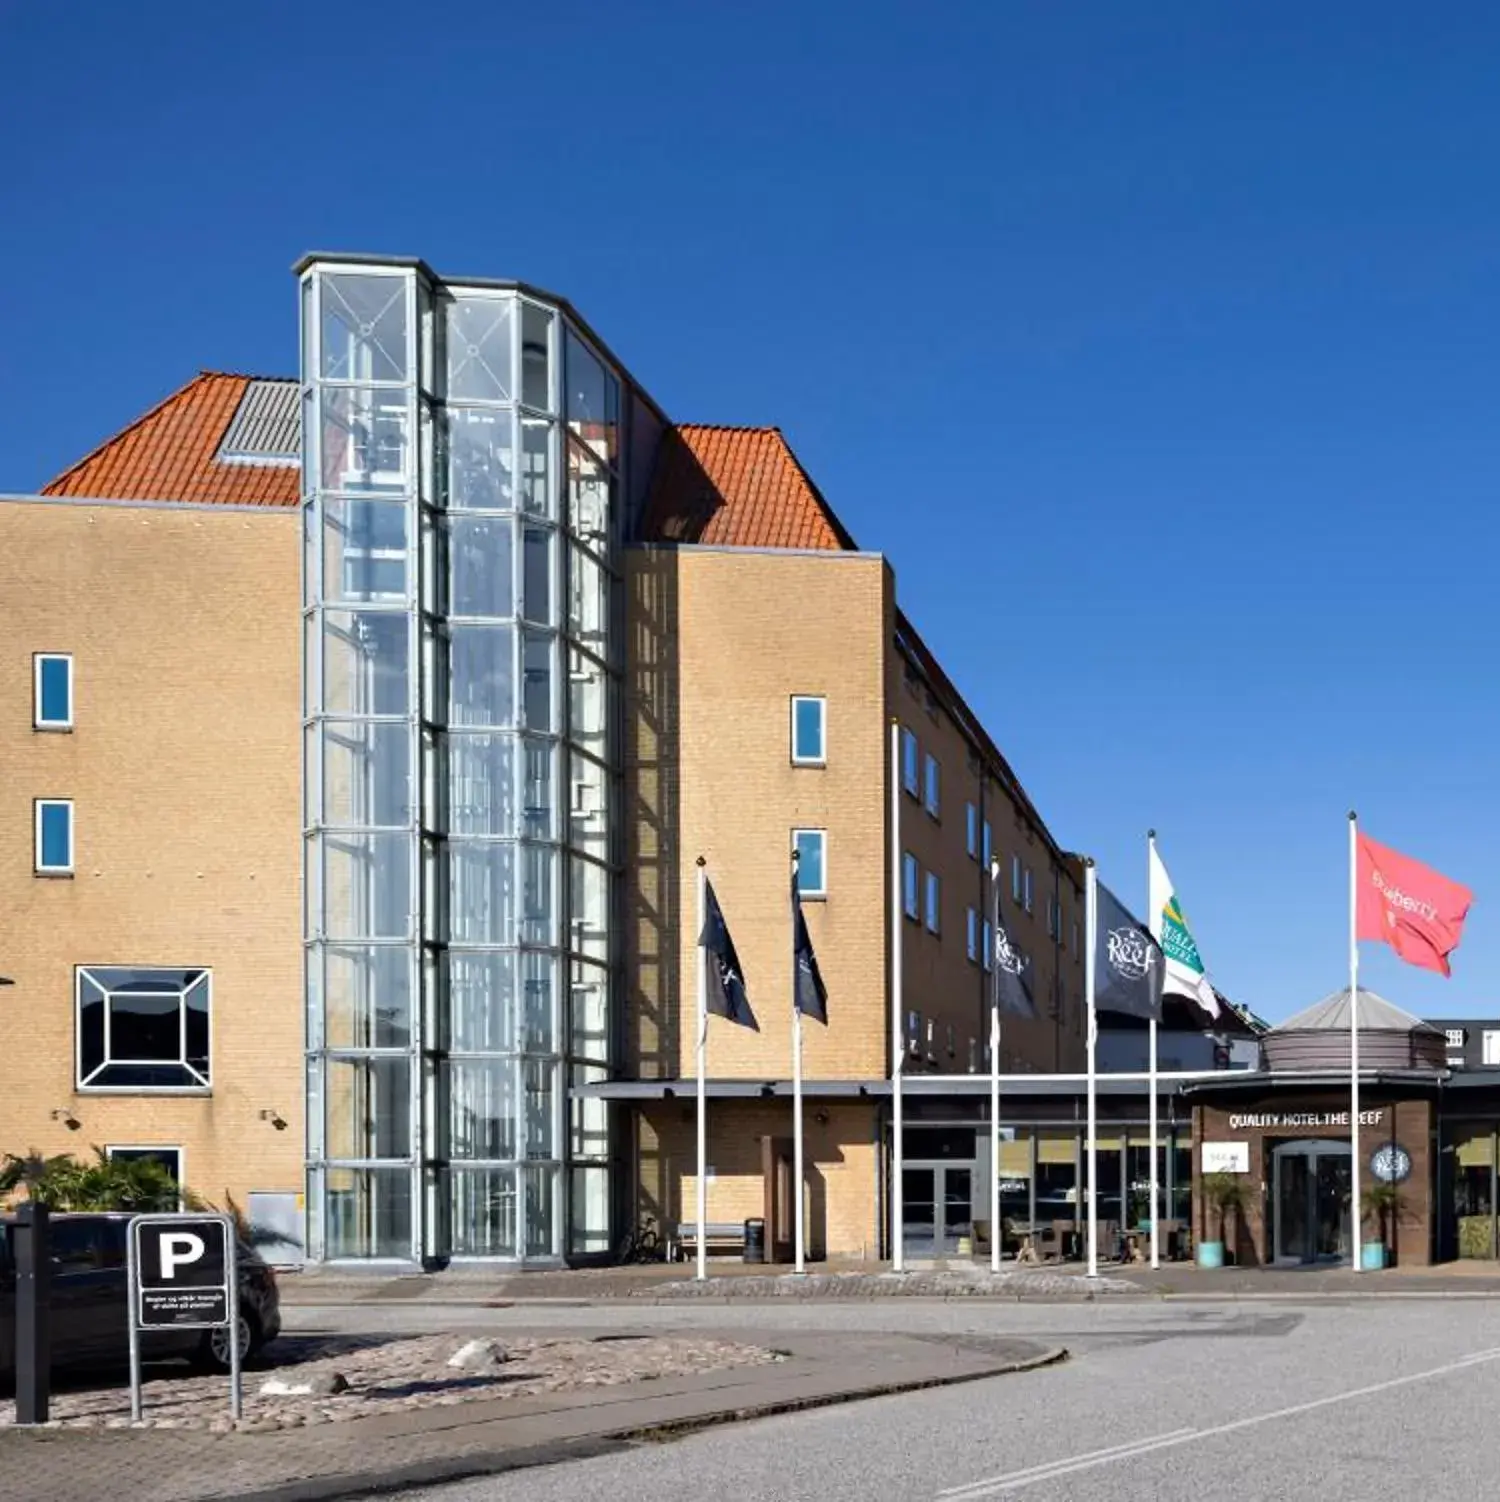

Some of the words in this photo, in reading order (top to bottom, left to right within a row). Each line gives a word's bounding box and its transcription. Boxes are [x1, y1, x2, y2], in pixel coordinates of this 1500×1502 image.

[1229, 1113, 1279, 1129] QUALITY
[1283, 1112, 1321, 1127] HOTEL
[1325, 1111, 1349, 1125] THE
[1354, 1110, 1383, 1125] EEF
[160, 1232, 205, 1279] P
